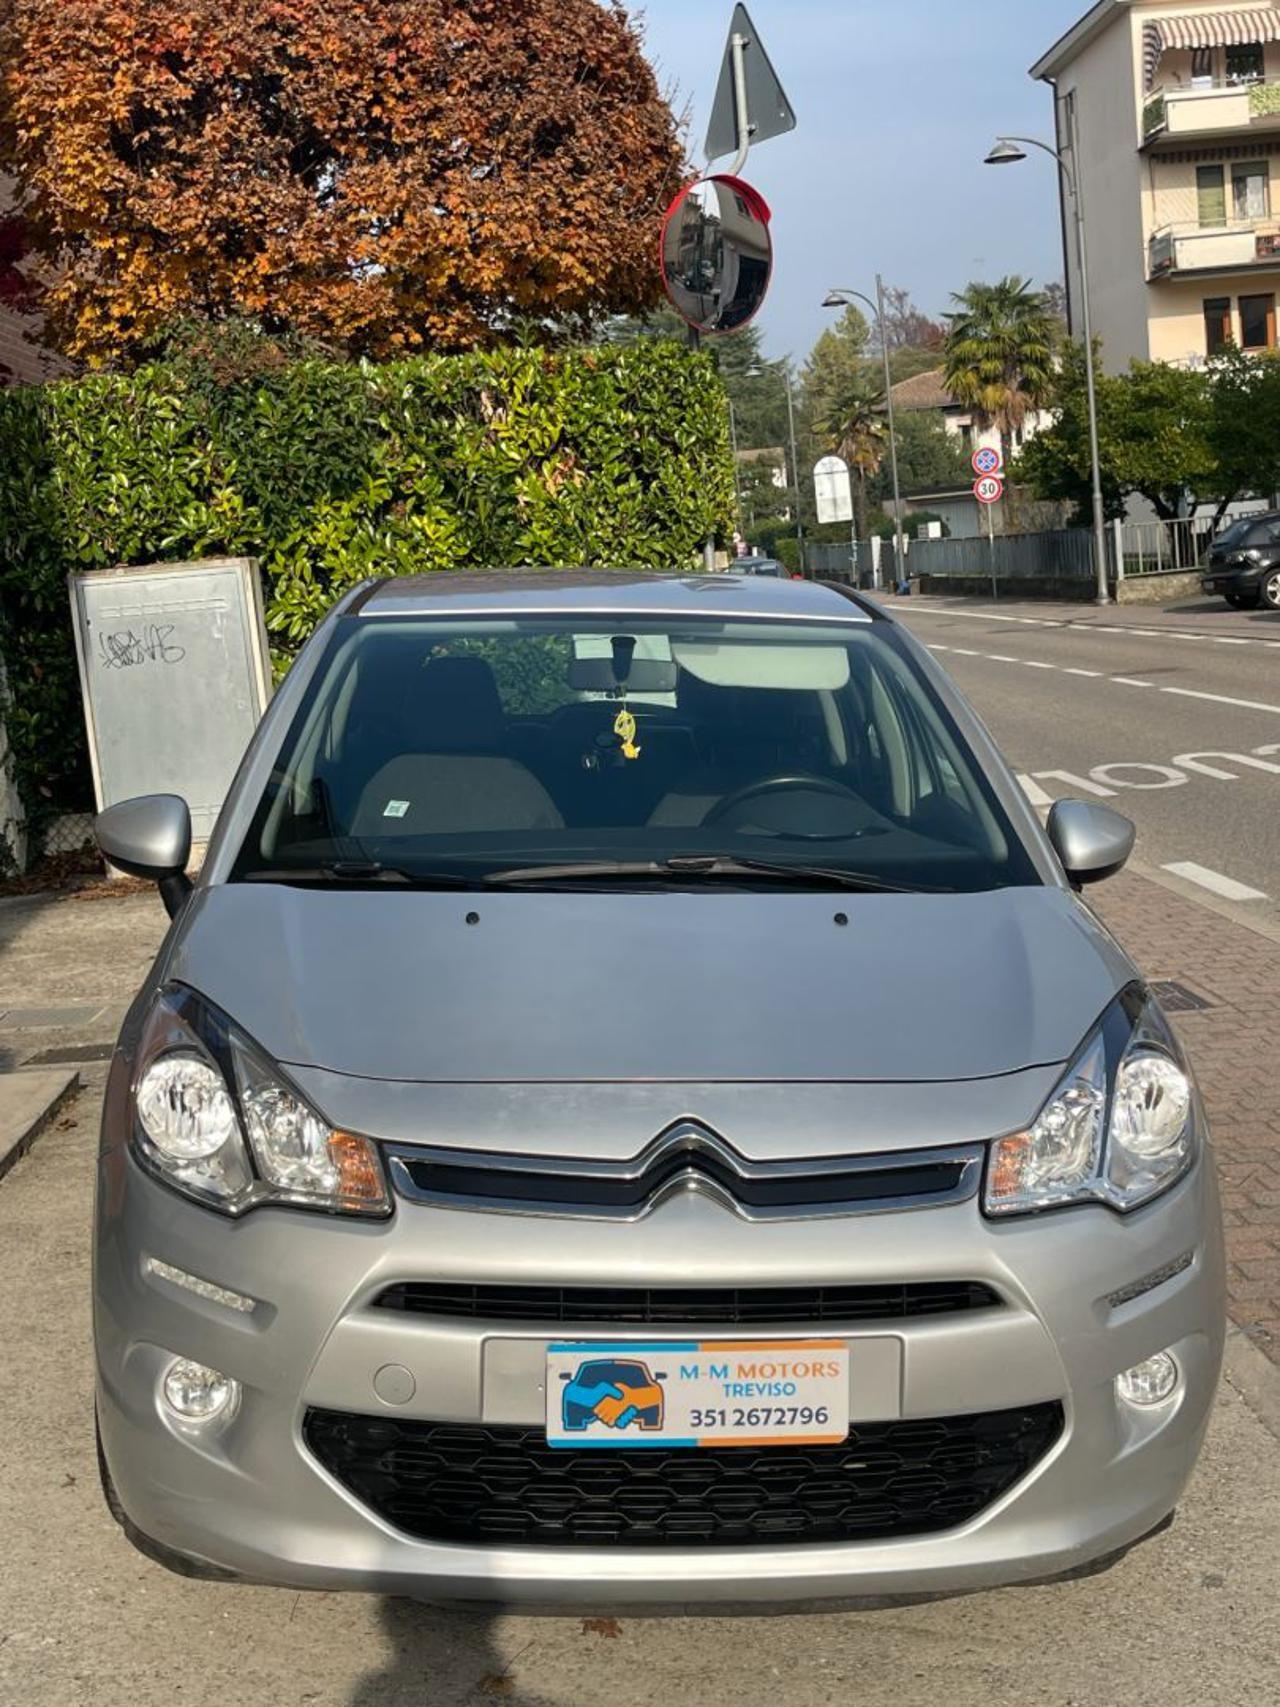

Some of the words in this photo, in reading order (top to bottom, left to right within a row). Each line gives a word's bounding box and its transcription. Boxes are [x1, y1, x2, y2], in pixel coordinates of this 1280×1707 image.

[981, 482, 996, 495] 30
[679, 1364, 729, 1379] M-M
[736, 1361, 840, 1379] MOTORS
[723, 1382, 797, 1398] TREVISO
[690, 1409, 726, 1427] 351
[732, 1406, 829, 1426] 2672796
